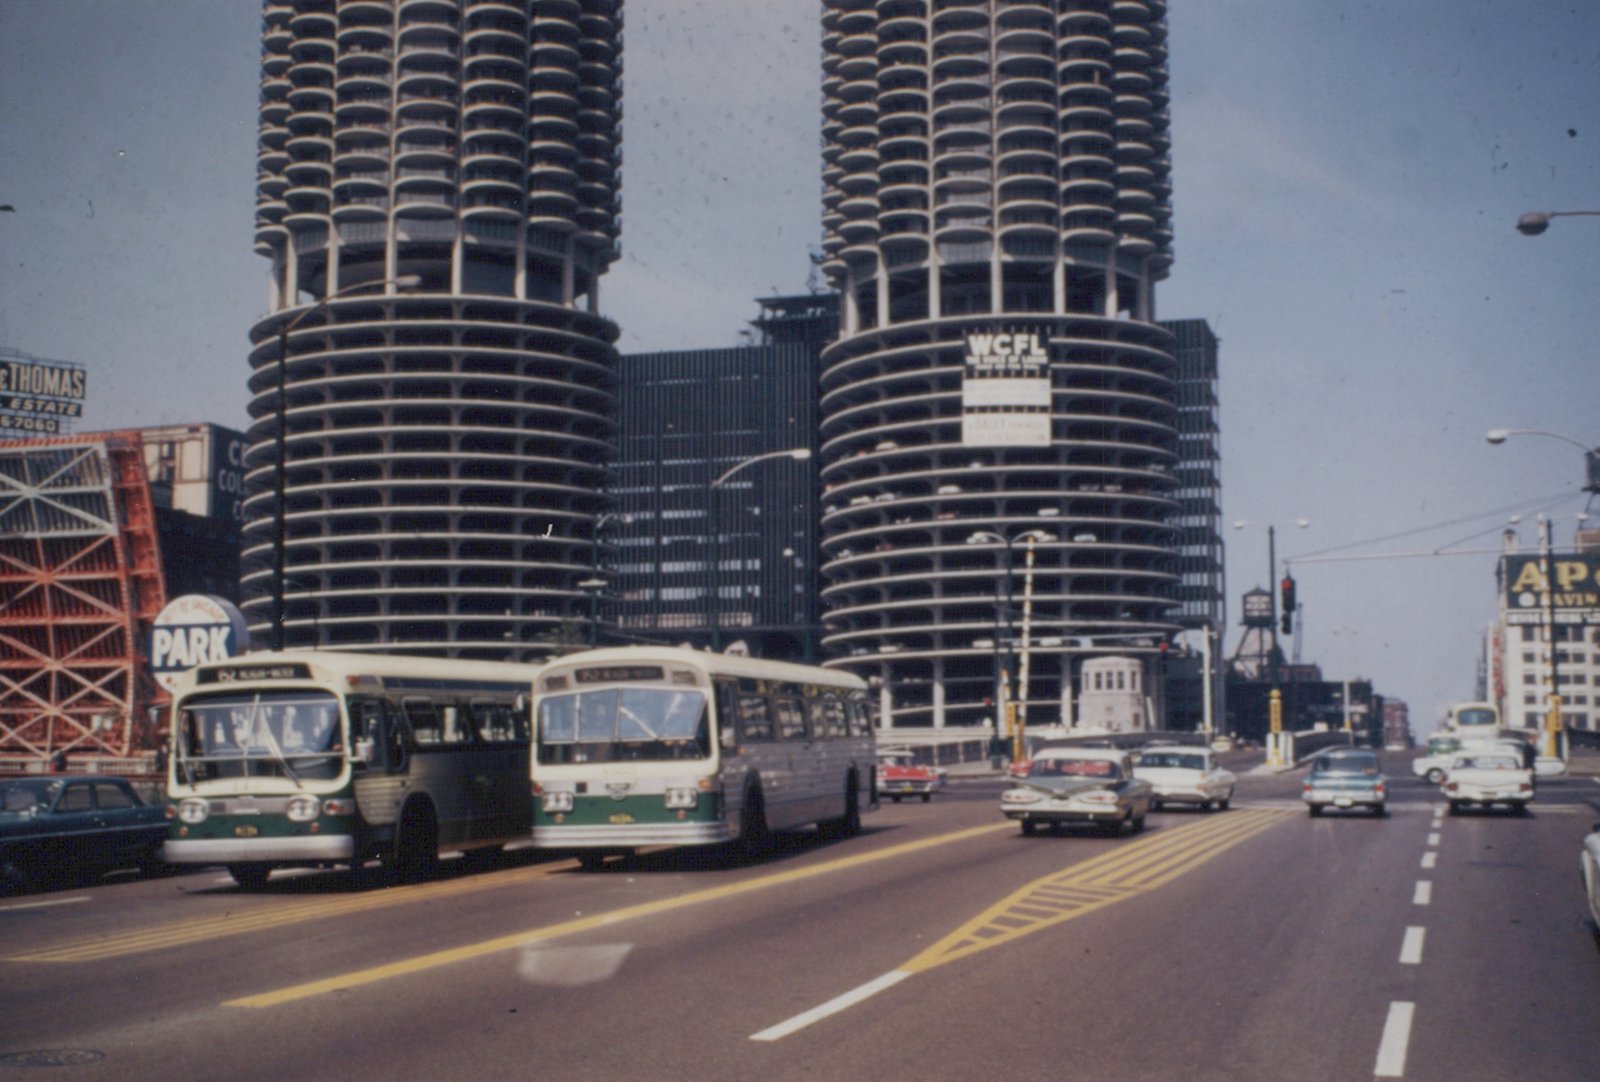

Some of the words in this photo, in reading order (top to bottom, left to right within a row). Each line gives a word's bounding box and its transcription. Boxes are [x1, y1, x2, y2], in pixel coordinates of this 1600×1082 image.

[968, 333, 1047, 356] WCFL
[8, 363, 84, 398] THOMAS
[10, 398, 79, 415] ESTATE
[1511, 560, 1600, 593] AP
[152, 626, 231, 668] PARK
